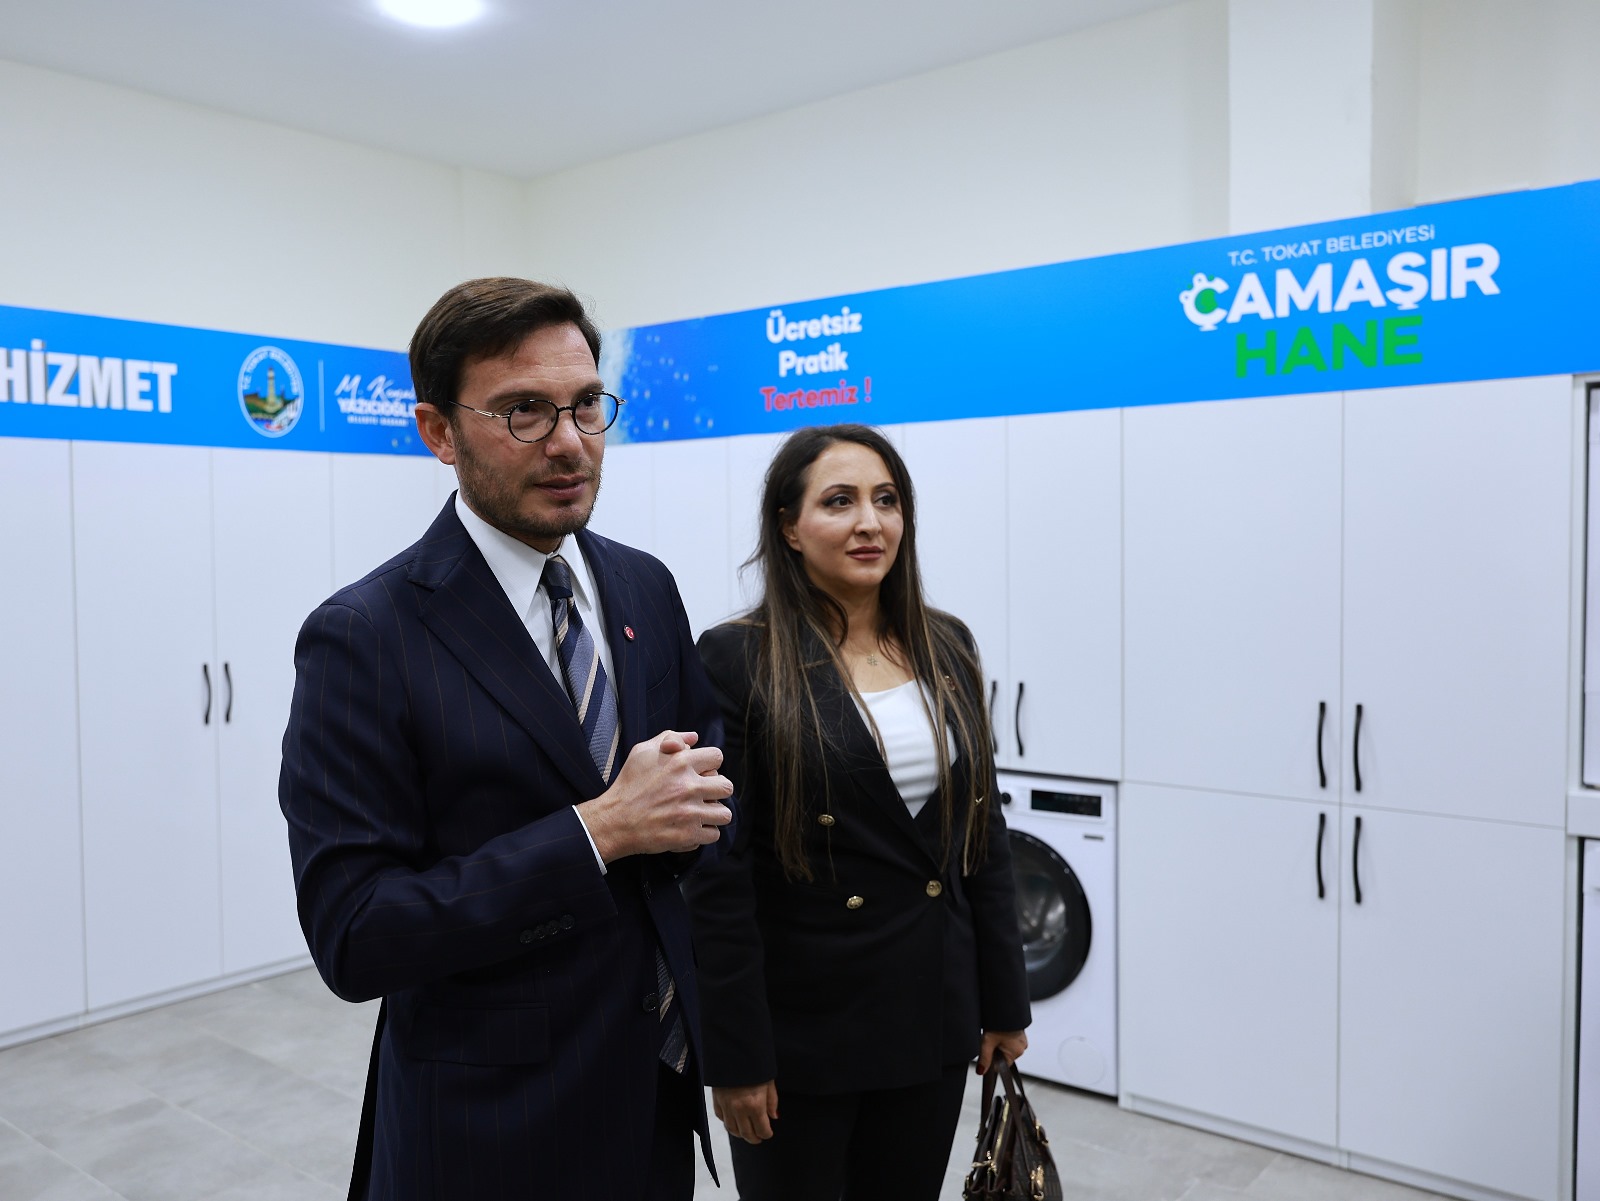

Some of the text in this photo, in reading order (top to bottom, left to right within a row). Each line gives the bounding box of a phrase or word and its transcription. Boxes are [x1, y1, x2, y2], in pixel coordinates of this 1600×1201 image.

[1228, 224, 1435, 266] T.C. TOKAT BELEDİYESİ
[1179, 242, 1501, 331] ÇAMAŞIR
[766, 306, 863, 343] Ücretsiz
[778, 342, 849, 378] Pratik
[1235, 315, 1423, 379] HANE
[0, 338, 179, 414] HİZMET
[760, 378, 859, 412] Tertemiz
